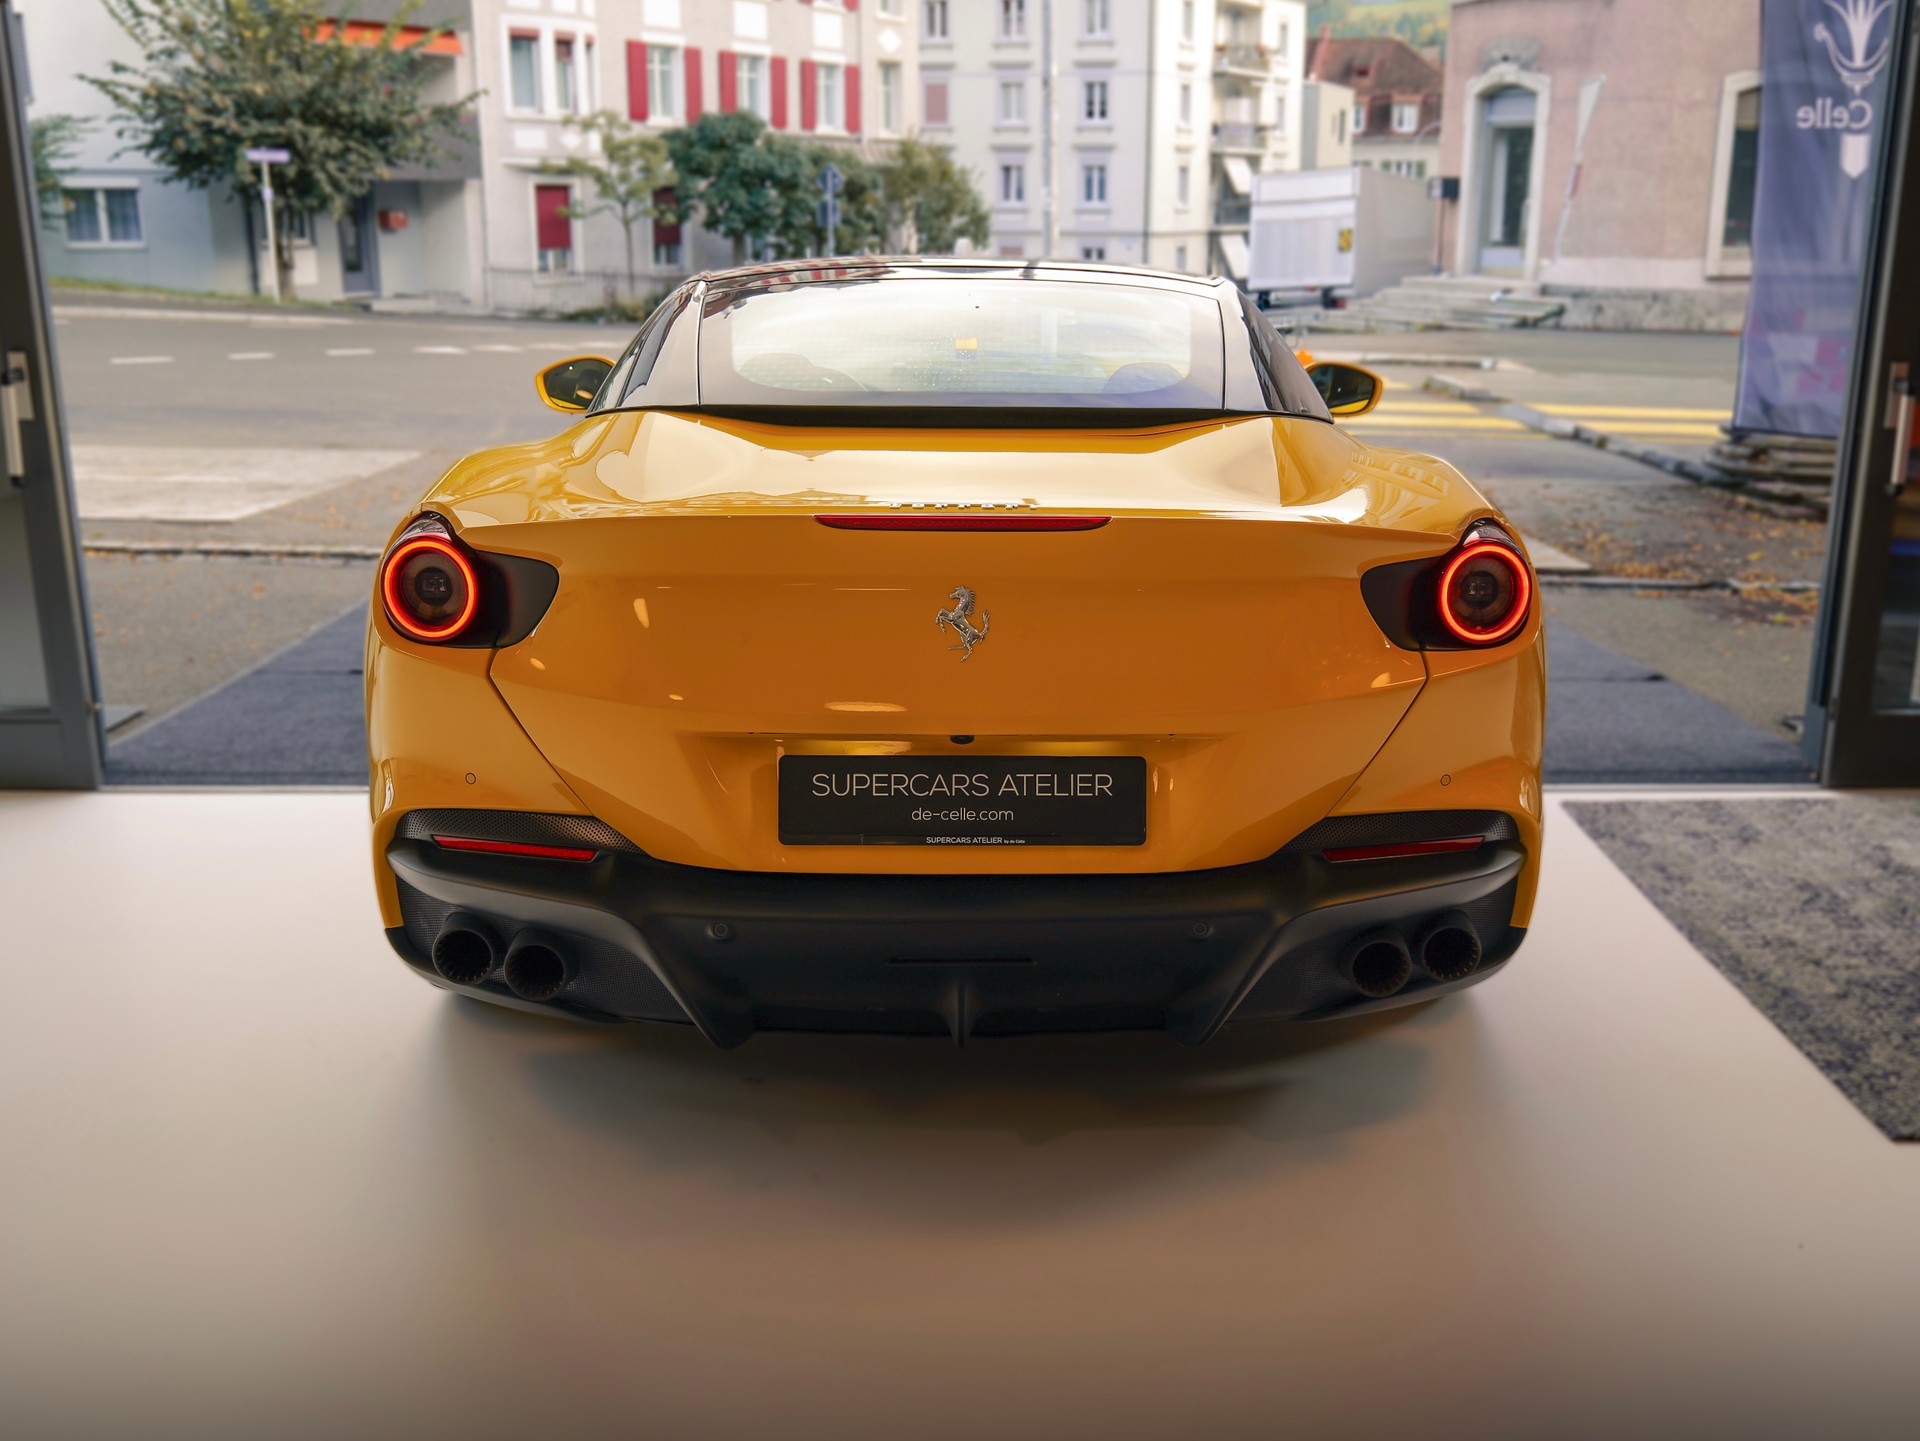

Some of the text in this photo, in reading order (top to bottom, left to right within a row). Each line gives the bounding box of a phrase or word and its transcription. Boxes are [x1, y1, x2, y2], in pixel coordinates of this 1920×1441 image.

[811, 773, 1113, 797] SUPERCARS ATELIER
[911, 807, 1014, 821] de-celle.com
[926, 836, 971, 844] SUPERCARS
[972, 836, 1002, 844] ATELIER
